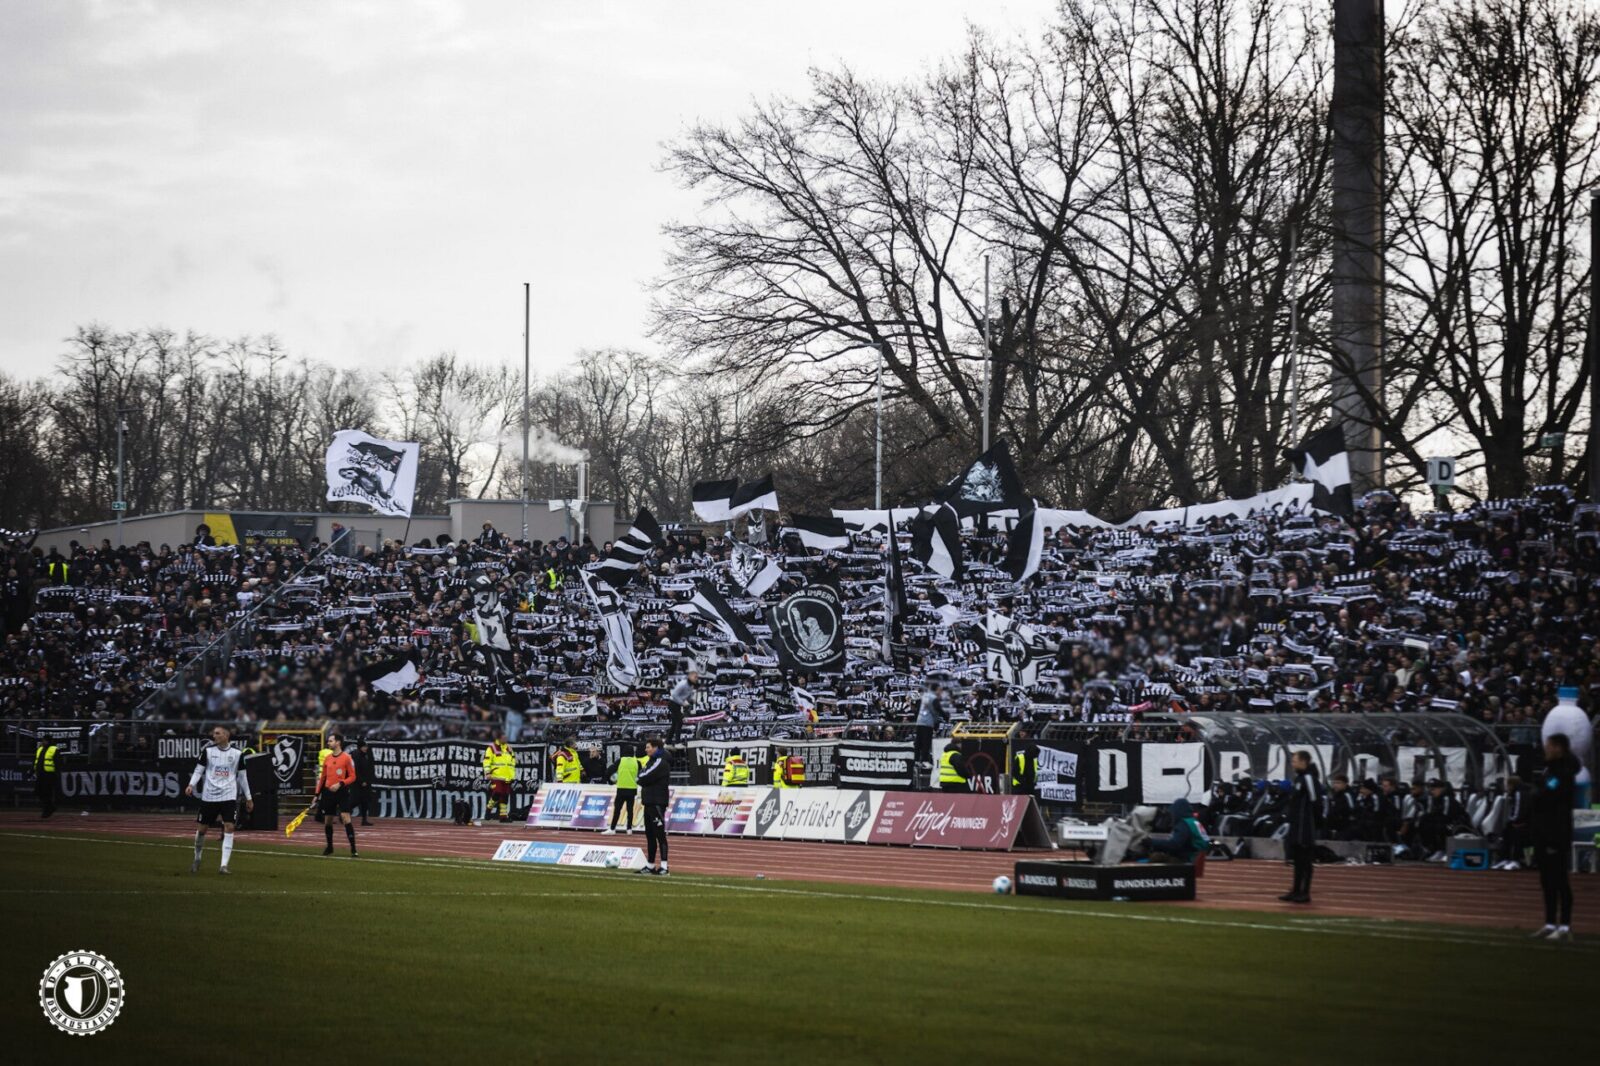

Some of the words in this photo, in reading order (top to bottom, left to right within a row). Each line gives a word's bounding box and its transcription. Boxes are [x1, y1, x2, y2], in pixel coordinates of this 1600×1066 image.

[1439, 461, 1452, 480] D
[158, 738, 199, 759] DONAU
[371, 747, 397, 762] WIR
[400, 746, 446, 763] HALTEN
[448, 745, 477, 762] FEST
[845, 758, 909, 773] constante
[1037, 747, 1076, 777] Ultras
[374, 764, 402, 780] UND
[404, 763, 447, 780] GEHEN
[515, 767, 539, 781] WEG
[61, 771, 180, 798] UNITEDS
[968, 776, 994, 795] VAR
[1042, 786, 1076, 801] immer
[780, 800, 842, 828] Barfüßer
[950, 816, 989, 830] FINNINGEN
[1024, 874, 1057, 886] BUNDESLIGA
[1068, 877, 1097, 890] BUNDESLIGA
[1113, 877, 1186, 890] BUNDESLIGA.DE
